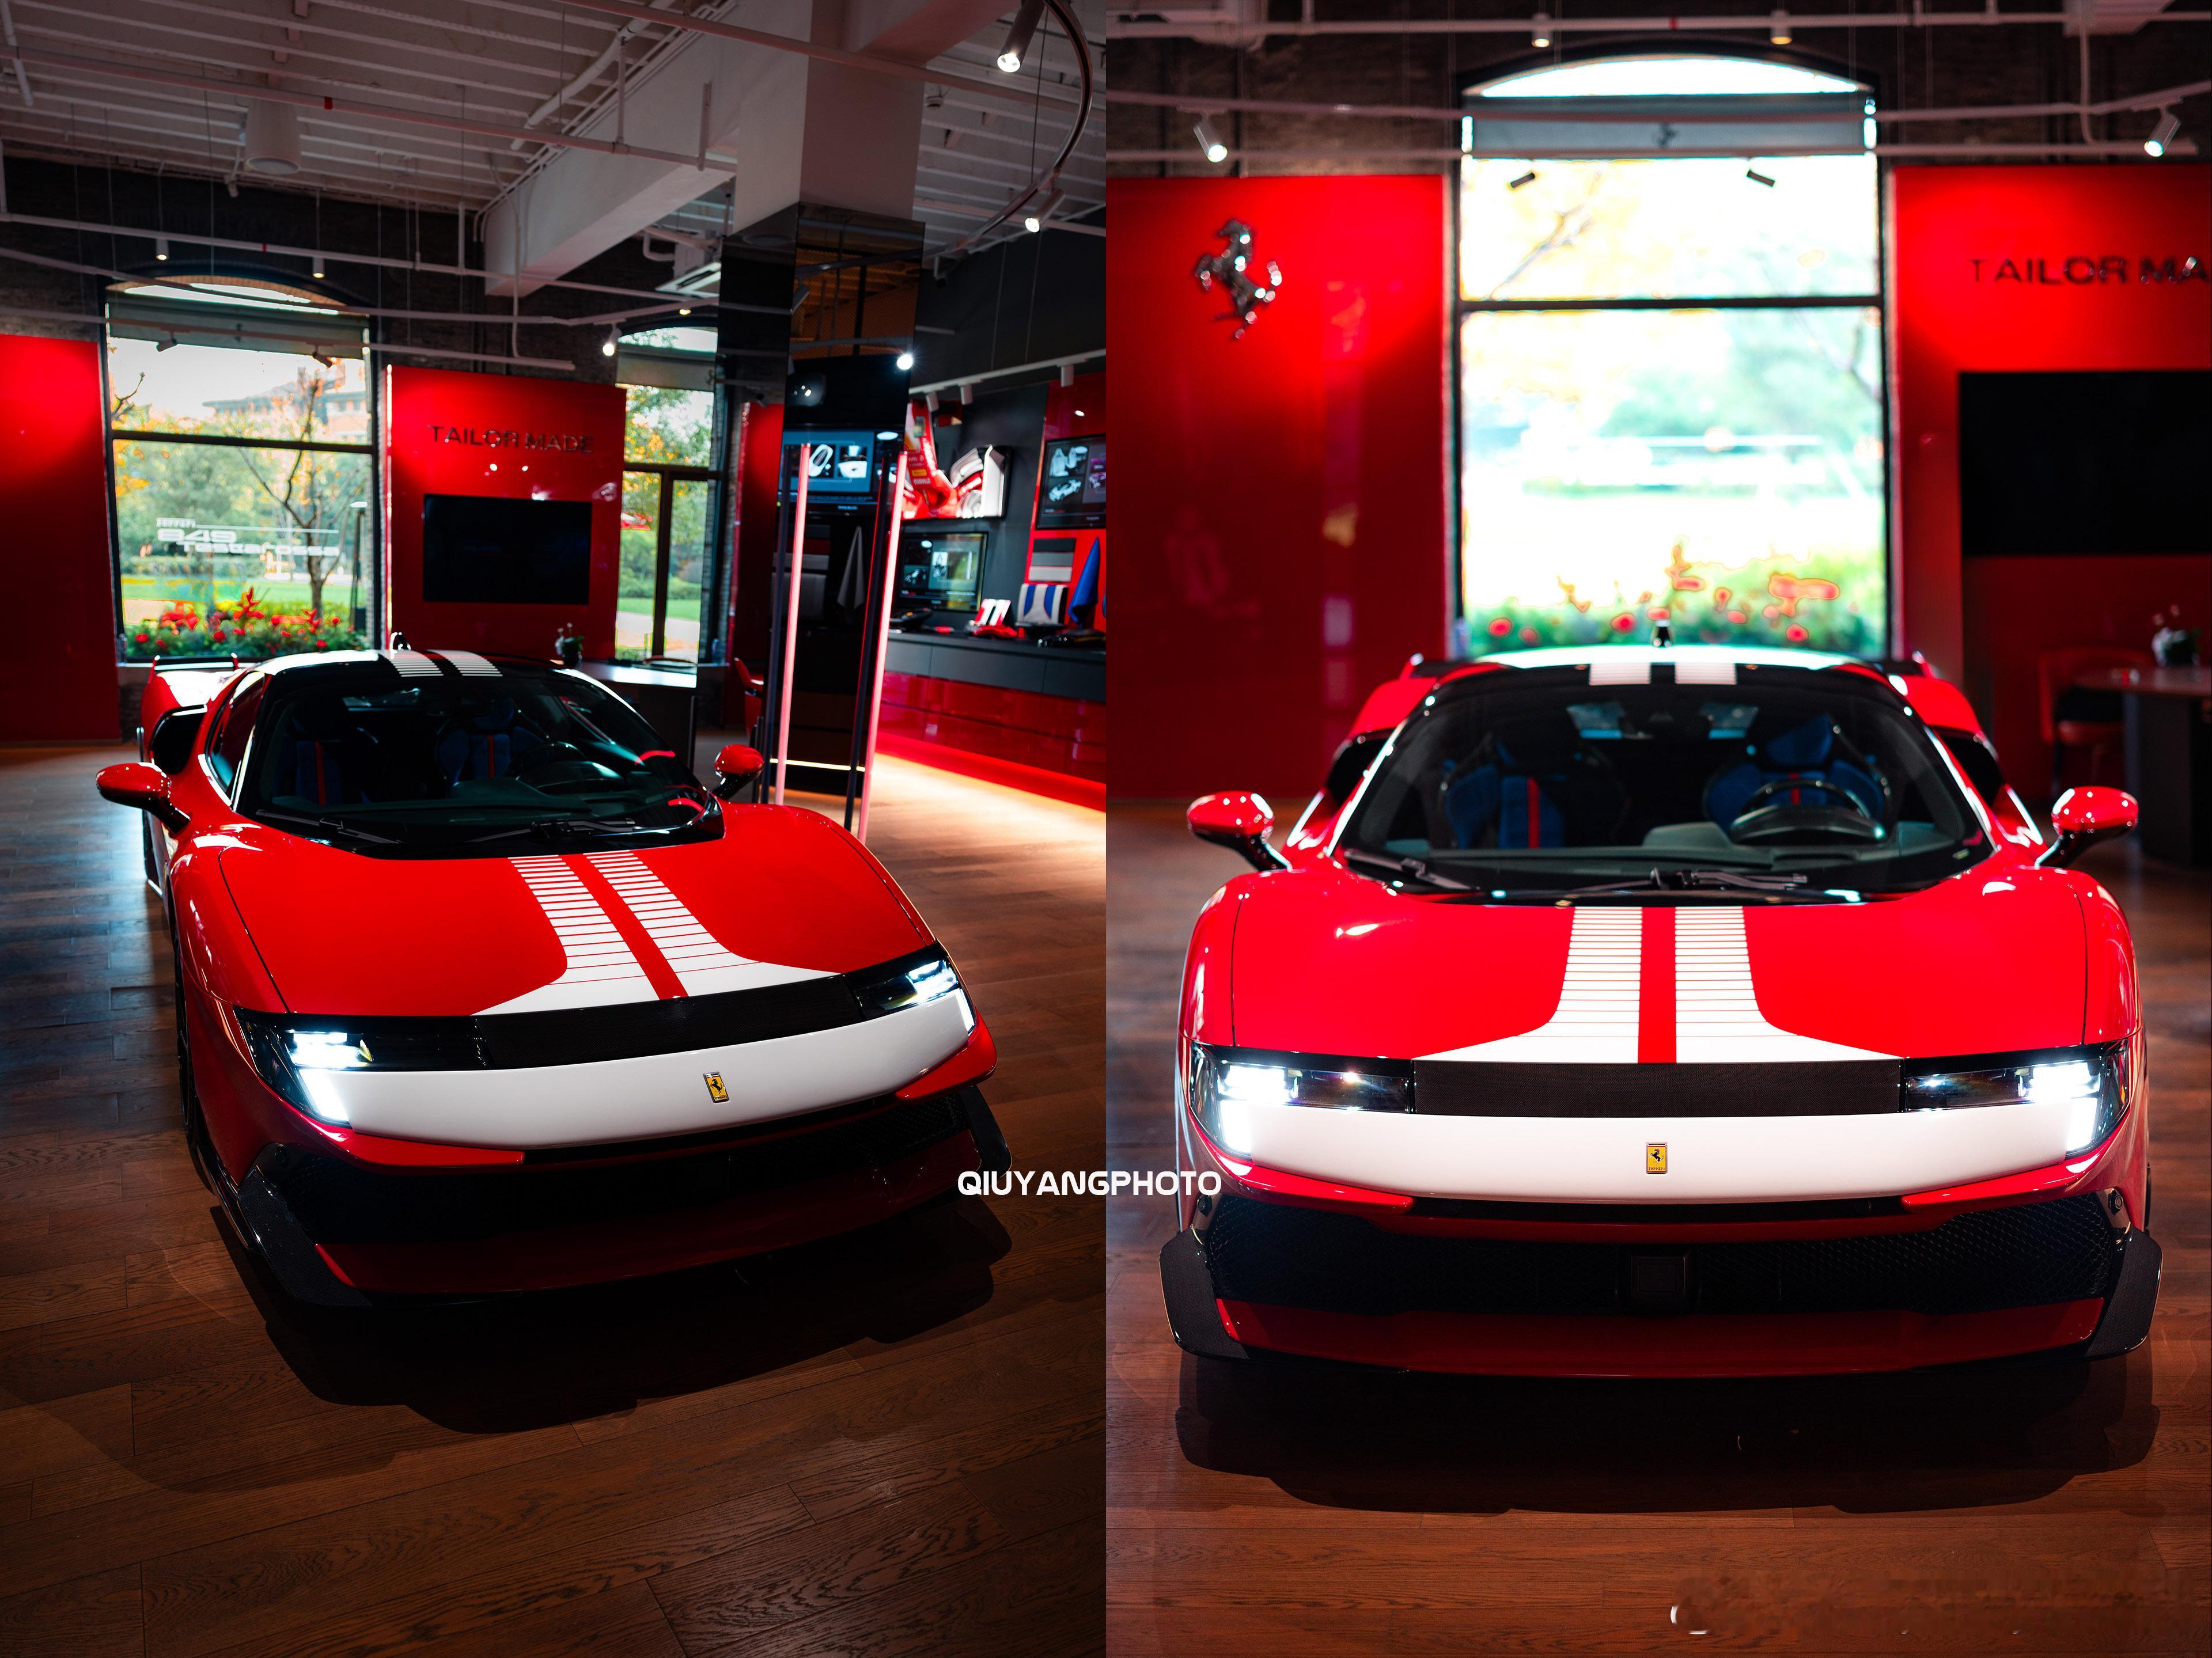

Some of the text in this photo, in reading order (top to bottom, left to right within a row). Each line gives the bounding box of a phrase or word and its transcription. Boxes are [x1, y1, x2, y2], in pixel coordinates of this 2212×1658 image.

[1967, 256, 2128, 284] TAILOR
[428, 425, 594, 454] TAILOR MADE
[157, 529, 237, 542] 849
[176, 540, 340, 556] Testarossa
